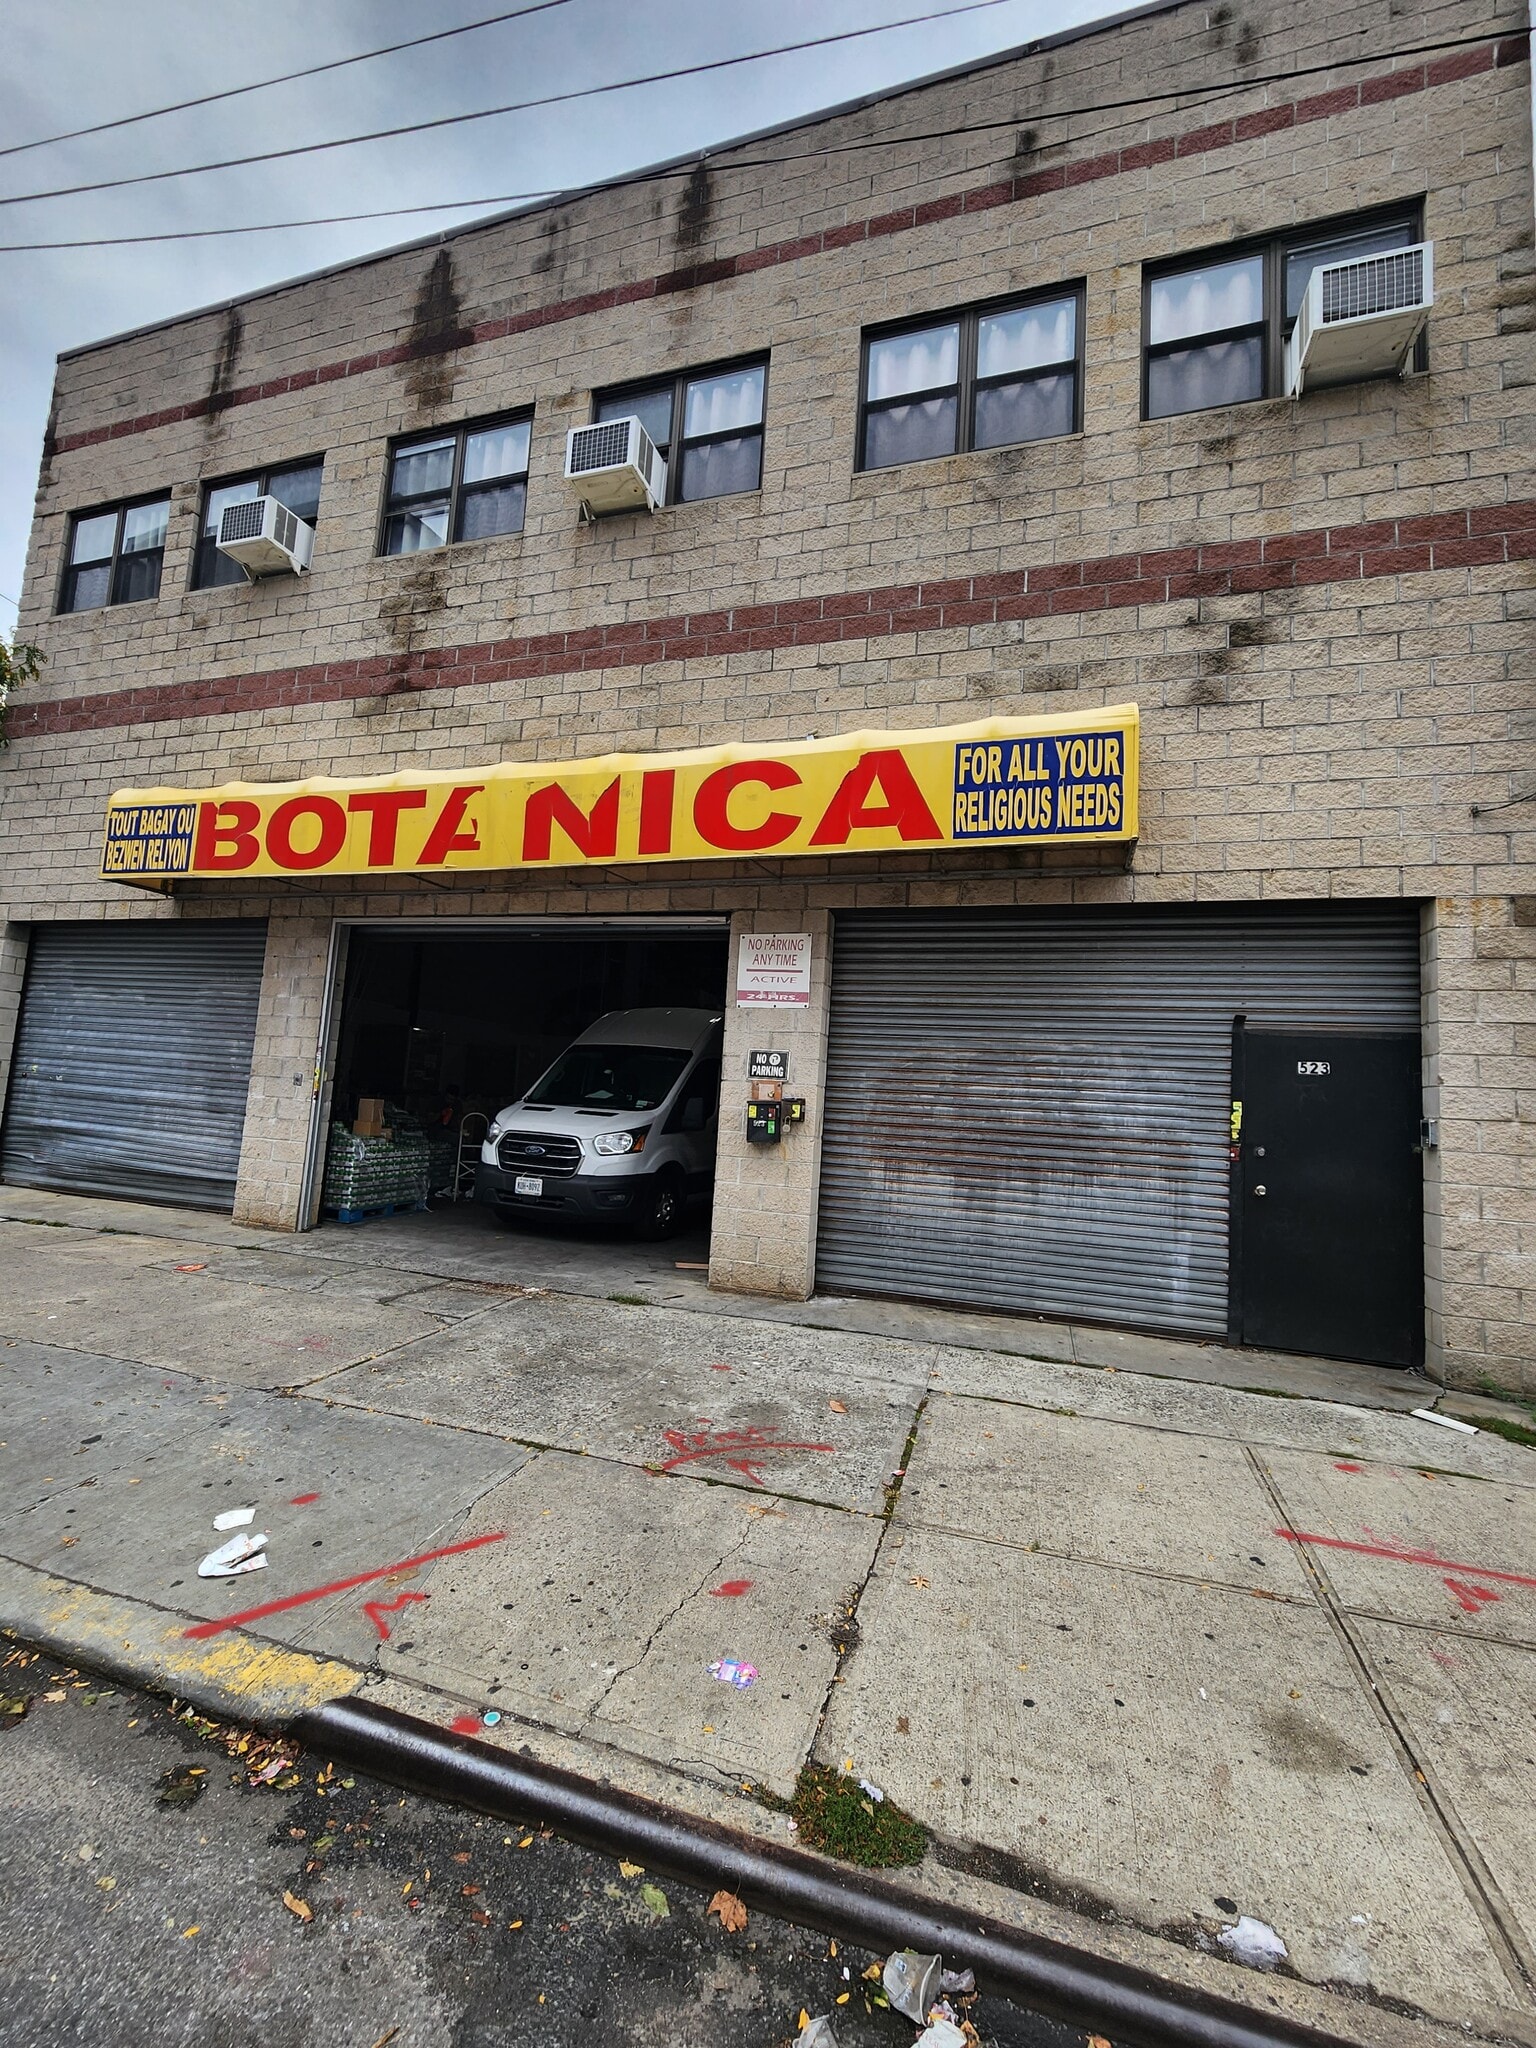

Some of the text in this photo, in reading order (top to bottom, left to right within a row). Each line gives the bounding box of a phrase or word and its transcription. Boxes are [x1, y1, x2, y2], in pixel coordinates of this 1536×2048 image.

[958, 737, 1121, 786] FOR ALL YOUR
[193, 748, 945, 871] BOTANICA
[955, 782, 1122, 833] RELIGIOUS NEEDS
[110, 807, 195, 837] TOUT BAGAY OU
[105, 837, 189, 871] BEZWEN RELIYON
[747, 938, 805, 951] NO PARKING
[752, 953, 798, 966] ANY TIME
[750, 975, 798, 984] ACTIVE
[756, 1053, 767, 1065] NO
[751, 1064, 784, 1078] PARKING
[1299, 1062, 1330, 1075] 523
